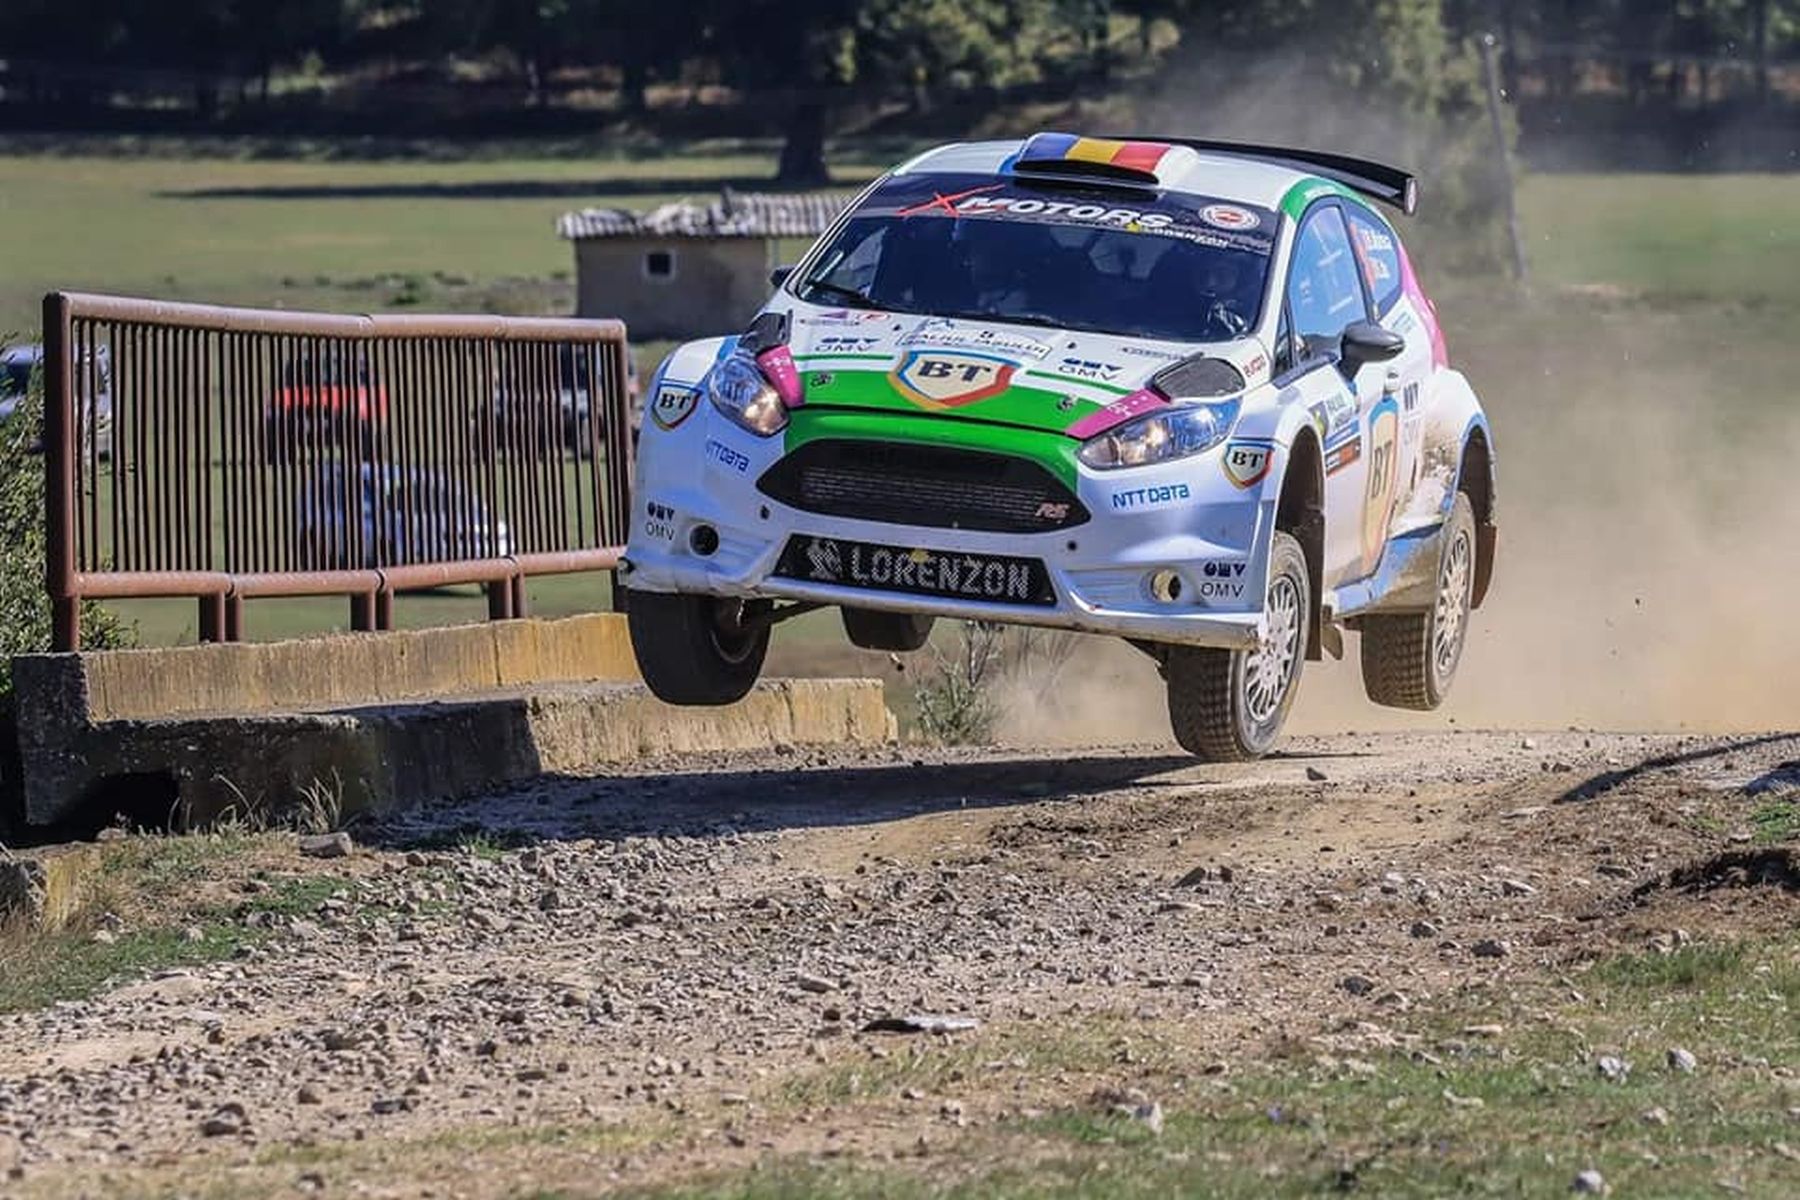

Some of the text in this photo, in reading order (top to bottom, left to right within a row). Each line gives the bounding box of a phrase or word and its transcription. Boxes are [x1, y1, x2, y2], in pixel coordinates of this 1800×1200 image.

[918, 360, 991, 382] BT
[660, 392, 691, 410] BT
[1230, 451, 1264, 469] BT
[1112, 488, 1145, 507] NTT
[1200, 582, 1244, 597] OMV
